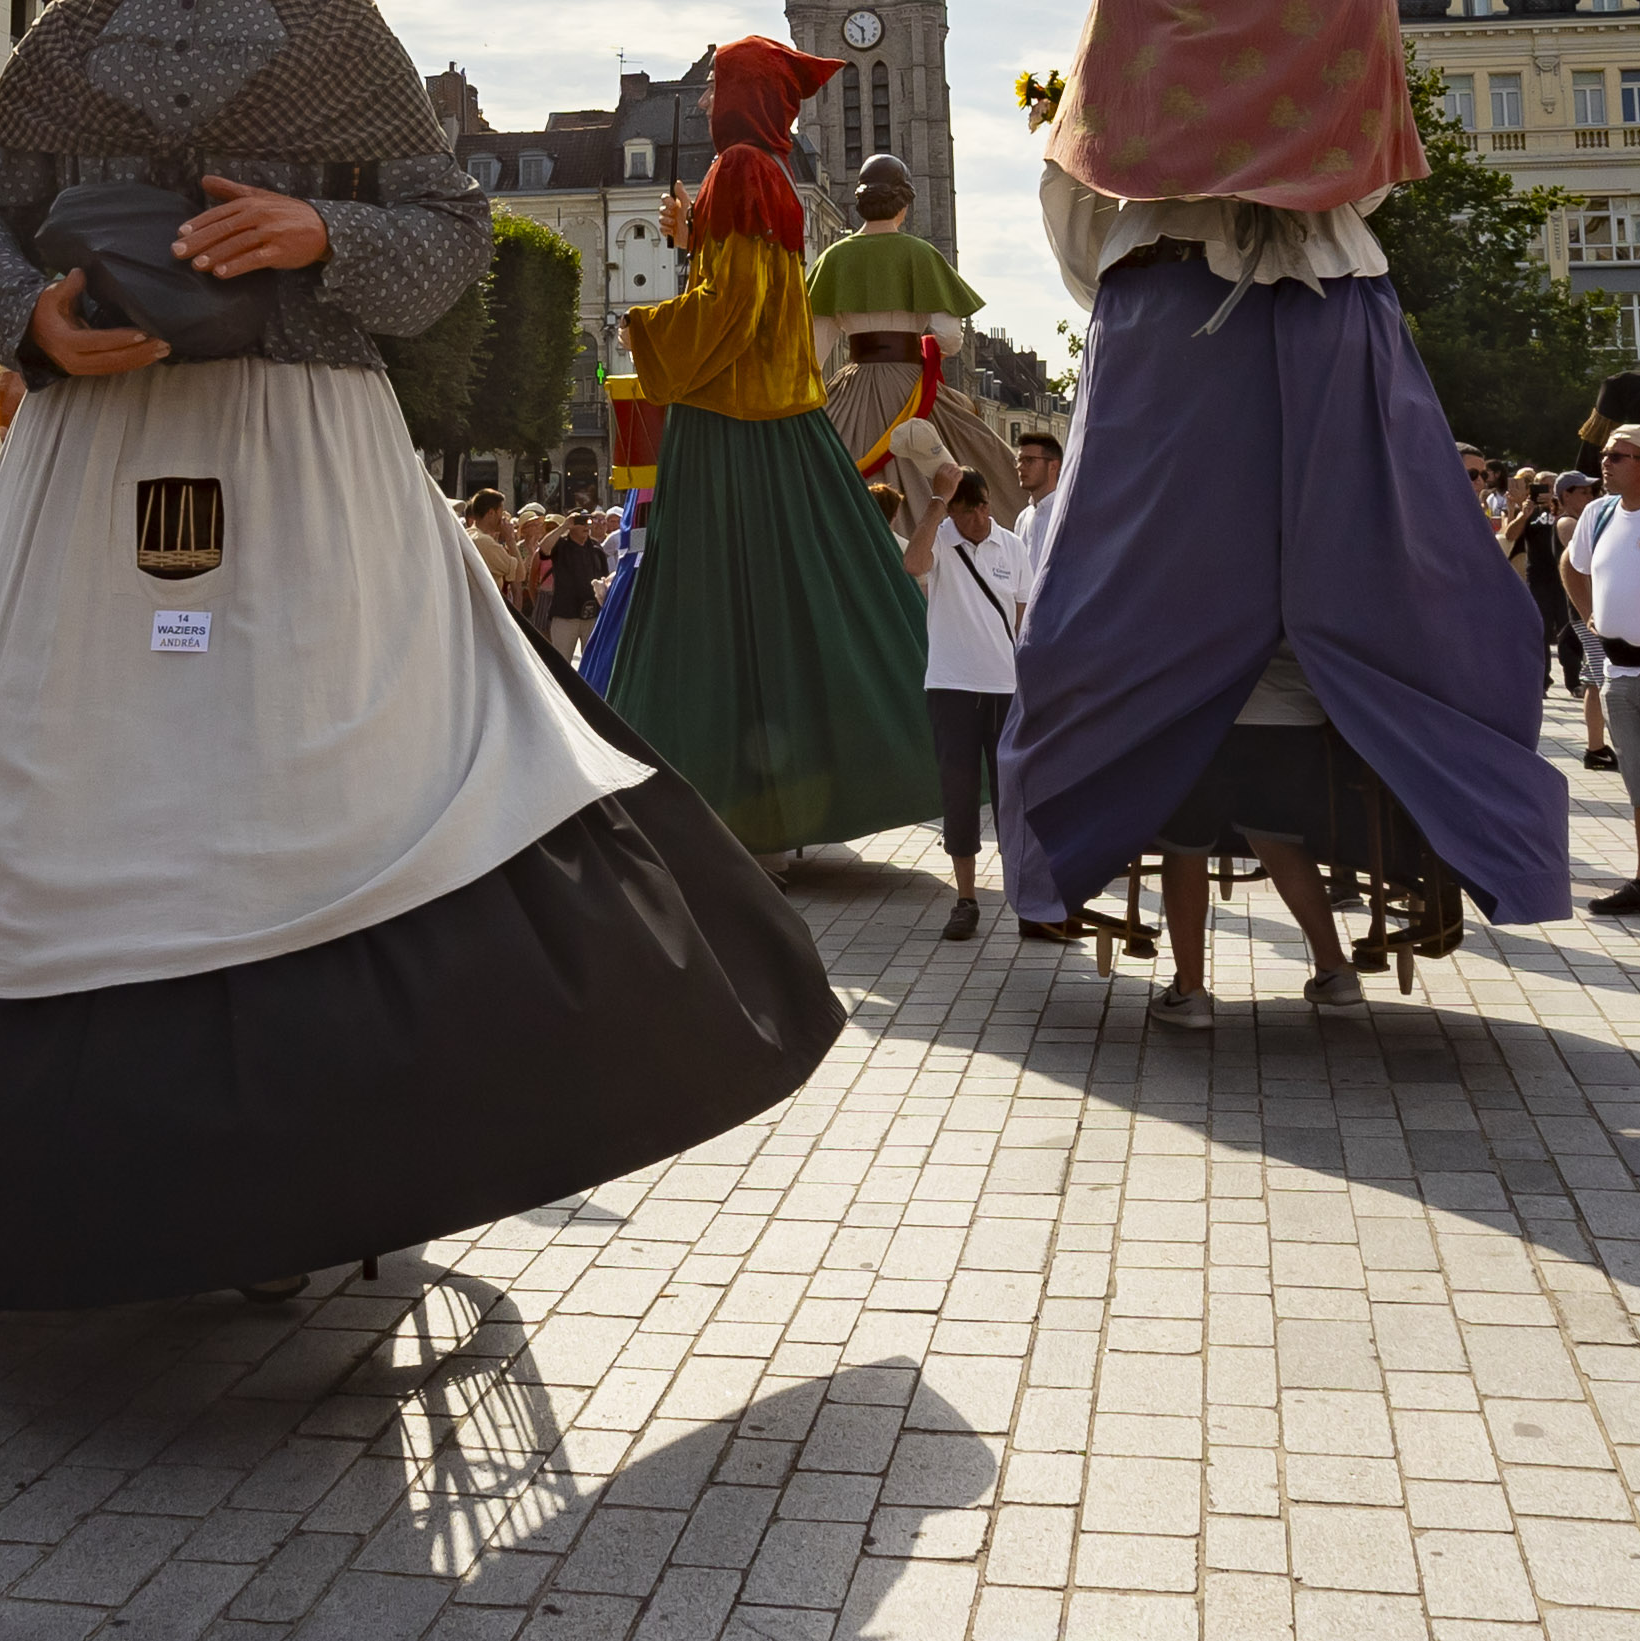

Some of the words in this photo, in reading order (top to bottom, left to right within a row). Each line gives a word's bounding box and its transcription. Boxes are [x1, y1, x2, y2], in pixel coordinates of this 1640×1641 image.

[178, 614, 189, 623] 14
[157, 625, 206, 635] WAZIERS
[159, 637, 200, 648] ANDRÉA
